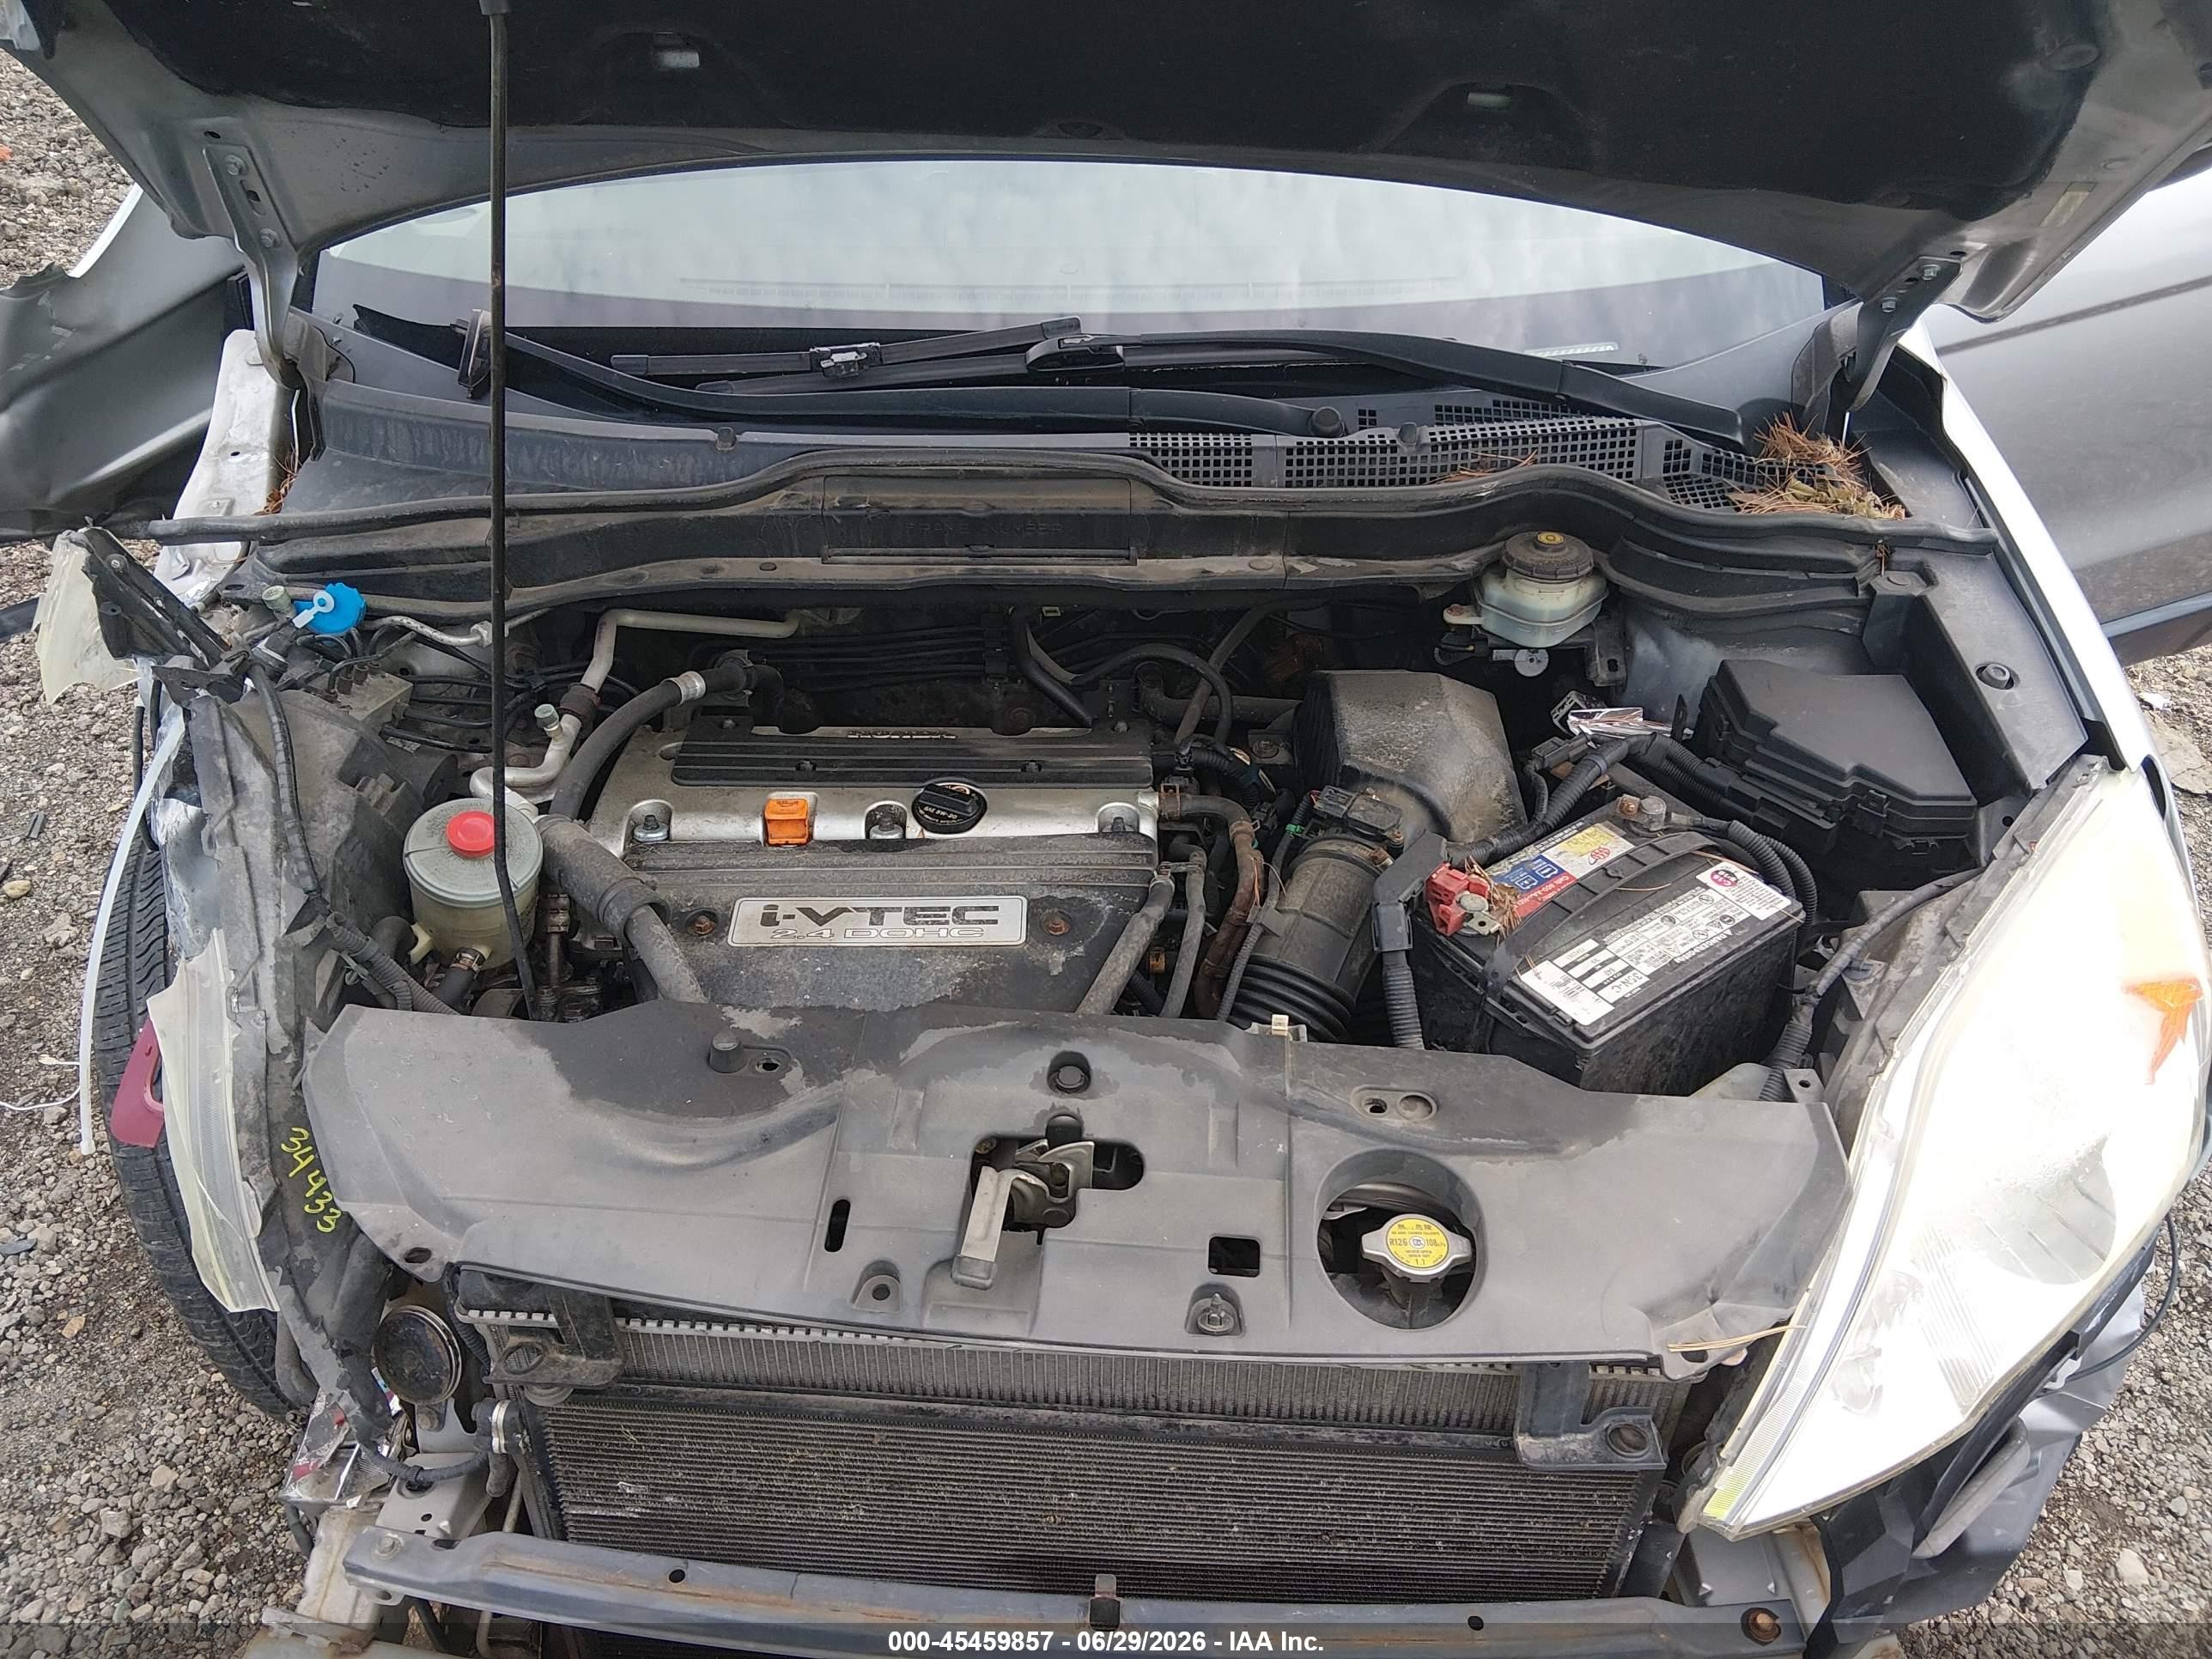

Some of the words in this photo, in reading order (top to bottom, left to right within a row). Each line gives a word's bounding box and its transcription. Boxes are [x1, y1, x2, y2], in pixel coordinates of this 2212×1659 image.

[760, 903, 1000, 927] i-VTEC
[770, 927, 835, 939] 2.4
[844, 927, 984, 939] DOHC
[1389, 1237, 1408, 1247] R126
